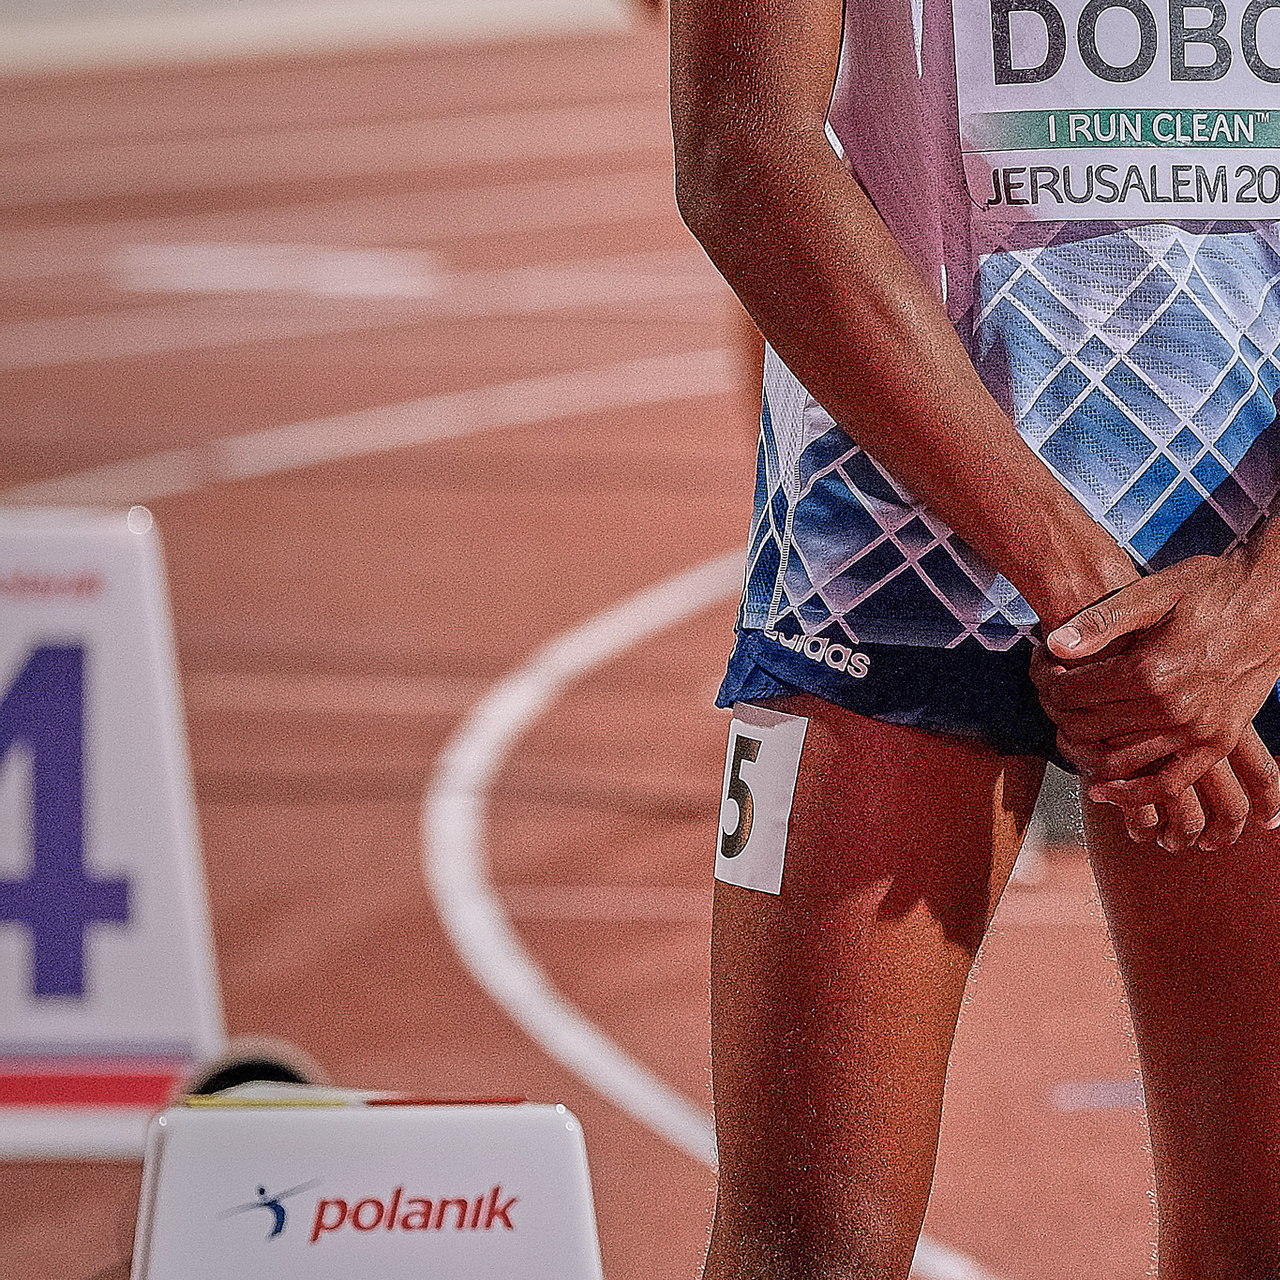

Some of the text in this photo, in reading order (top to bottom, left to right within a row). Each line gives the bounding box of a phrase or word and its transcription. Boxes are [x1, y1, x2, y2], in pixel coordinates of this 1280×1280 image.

[1049, 114, 1056, 143] I
[1069, 113, 1142, 143] RUN
[987, 164, 1228, 207] JERUSALEM
[720, 733, 763, 860] 5
[308, 1184, 518, 1245] polanik
